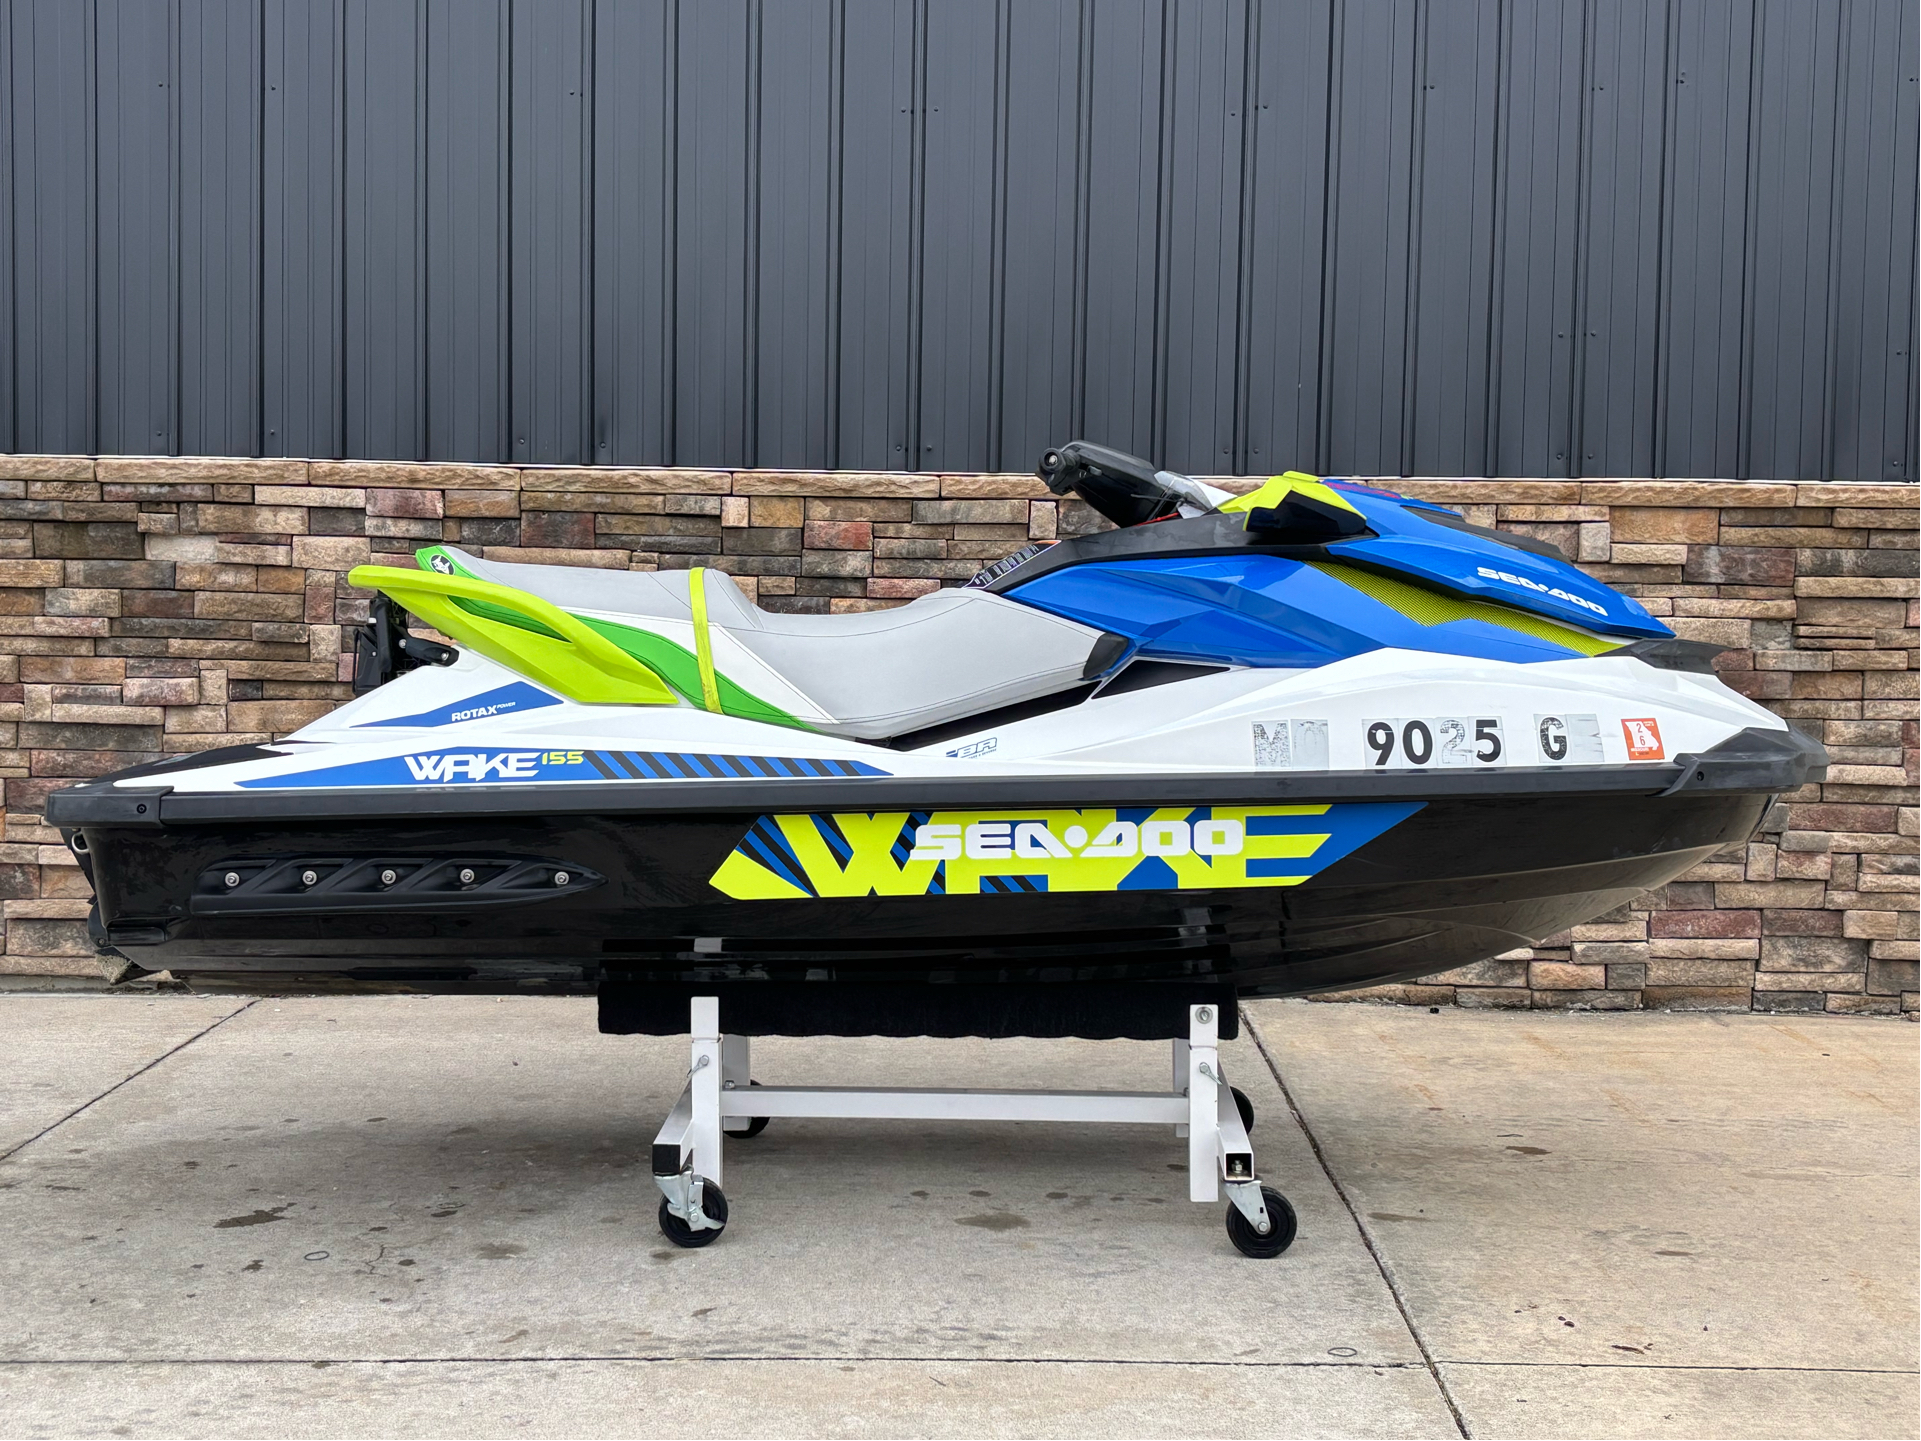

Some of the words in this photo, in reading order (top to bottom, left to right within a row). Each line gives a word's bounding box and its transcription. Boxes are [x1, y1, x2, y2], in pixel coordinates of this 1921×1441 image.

[452, 705, 497, 721] ROTAX
[496, 701, 516, 710] POWER
[1366, 719, 1501, 766] 9025
[404, 752, 541, 782] WAKE
[542, 751, 585, 765] 155
